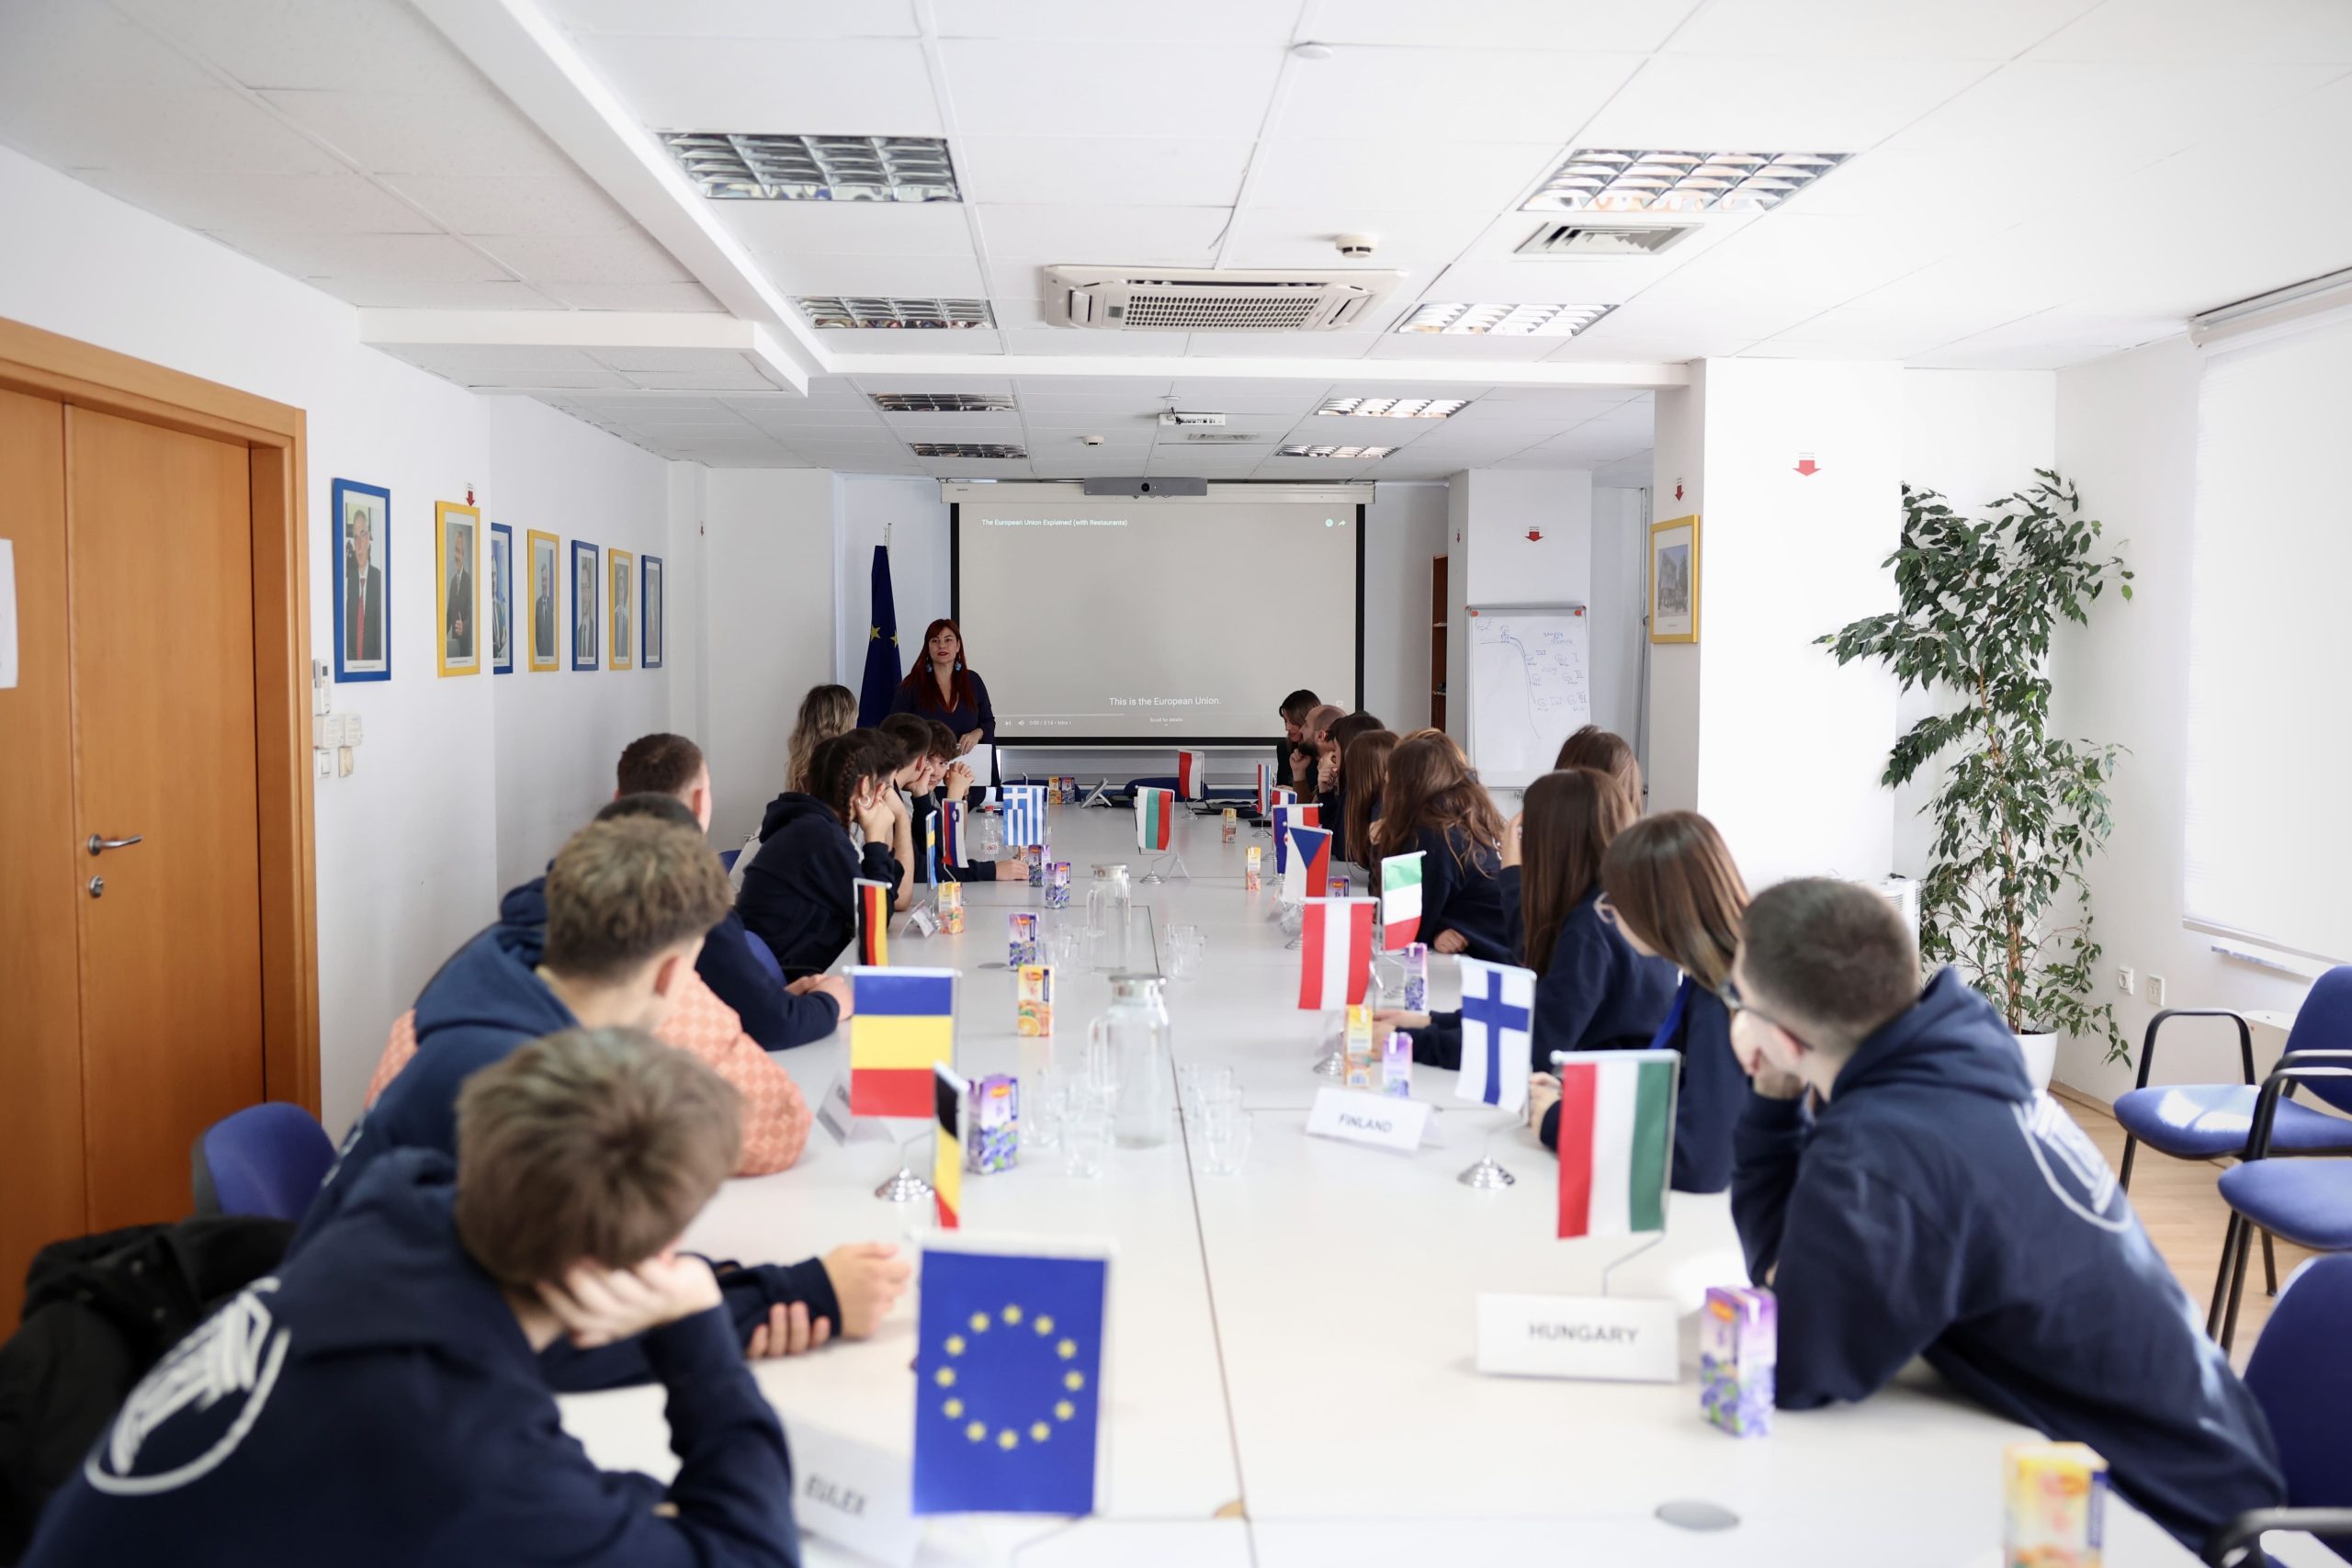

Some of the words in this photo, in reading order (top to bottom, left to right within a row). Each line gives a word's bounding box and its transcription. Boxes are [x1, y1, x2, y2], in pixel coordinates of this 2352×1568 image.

[994, 519, 1023, 528] European
[1043, 519, 1071, 528] Explained
[1073, 519, 1088, 528] (with
[1089, 519, 1127, 528] Restaurants)
[1109, 697, 1127, 705] This
[1129, 697, 1137, 705] is
[1138, 697, 1152, 705] the
[1154, 696, 1193, 707] European
[1194, 696, 1221, 705] Union.
[1339, 1112, 1392, 1133] FINLAND
[1529, 1324, 1639, 1344] HUNGARY
